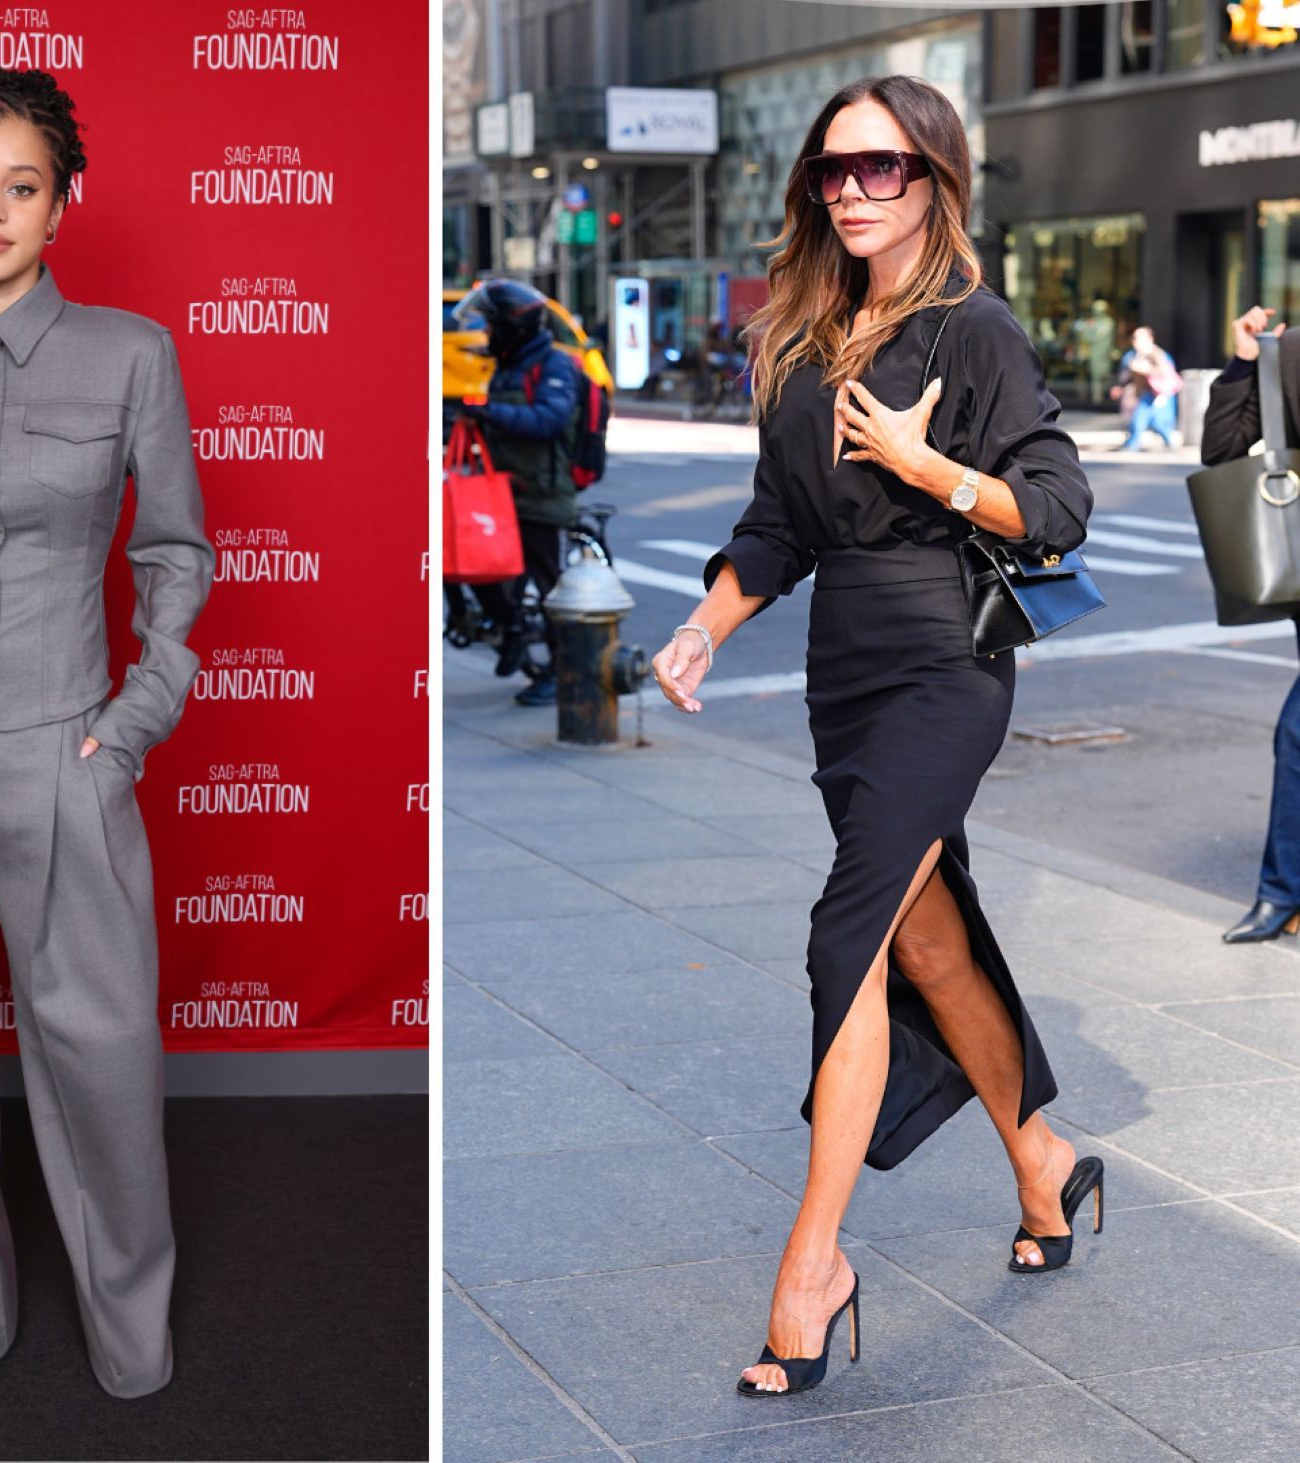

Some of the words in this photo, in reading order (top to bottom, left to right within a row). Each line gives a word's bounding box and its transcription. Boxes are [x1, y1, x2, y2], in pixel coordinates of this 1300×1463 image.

[227, 9, 306, 29] SAG-AFTRA
[194, 33, 338, 70] FOUNDATION
[224, 146, 301, 165] SAG-AFTRA
[191, 169, 333, 204] FOUNDATION
[222, 277, 296, 296] SAG-AFTRA
[189, 300, 328, 334] FOUNDATION
[219, 405, 292, 424] SAG-AFTRA
[216, 529, 289, 546] SAG-AFTRA
[213, 550, 320, 582] UNDATION
[212, 648, 284, 666] SAG-AFTRA
[194, 668, 315, 700] OUNDATION
[209, 764, 280, 780] SAG-AFTRA
[179, 784, 309, 814] FOUNDATION
[206, 875, 275, 891] SAG-AFTRA
[176, 894, 303, 923] FOUNDATION
[201, 982, 269, 997] SAG-AFTRA
[172, 1000, 298, 1028] FOUNDATION
